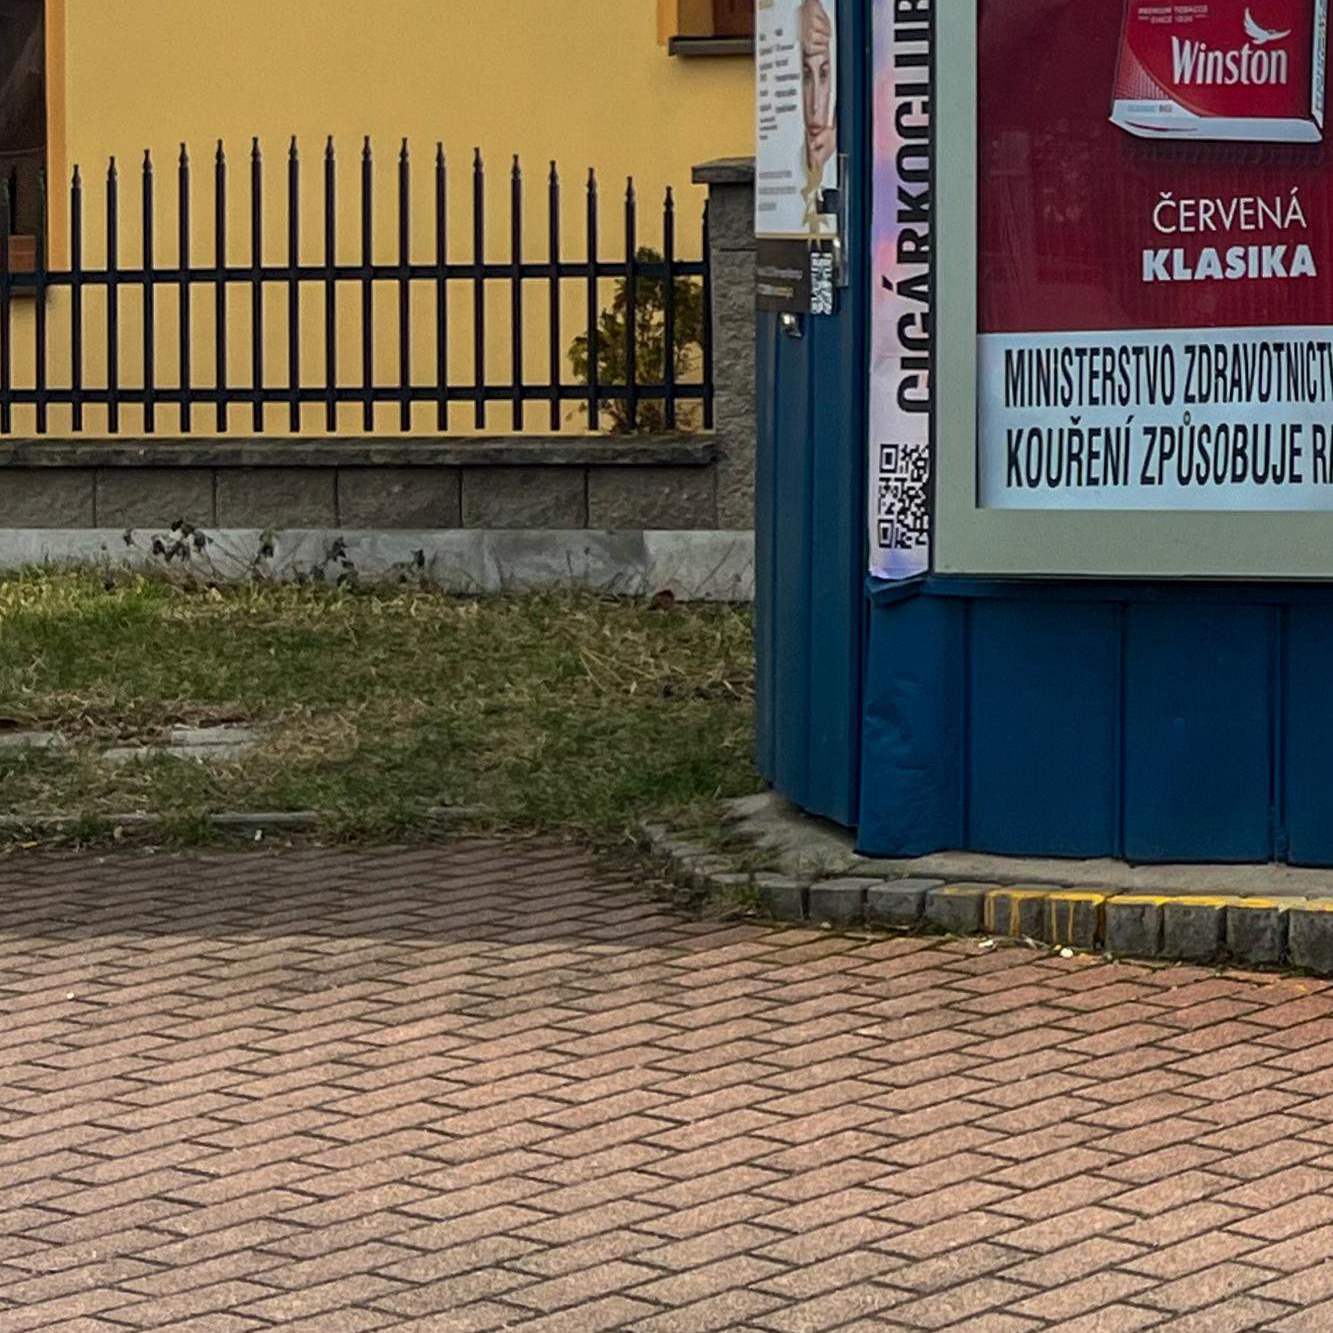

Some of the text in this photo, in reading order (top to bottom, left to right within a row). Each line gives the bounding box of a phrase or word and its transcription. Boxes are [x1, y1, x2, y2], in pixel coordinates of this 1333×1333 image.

[1172, 35, 1288, 85] Winston
[1152, 188, 1306, 234] ČERVENÁ
[1142, 245, 1316, 282] KLASIKA
[1005, 344, 1175, 407] MINISTERSTVO
[1006, 415, 1133, 488] KOUŘENÍ
[1141, 410, 1303, 486] ZPŮSOBUJE
